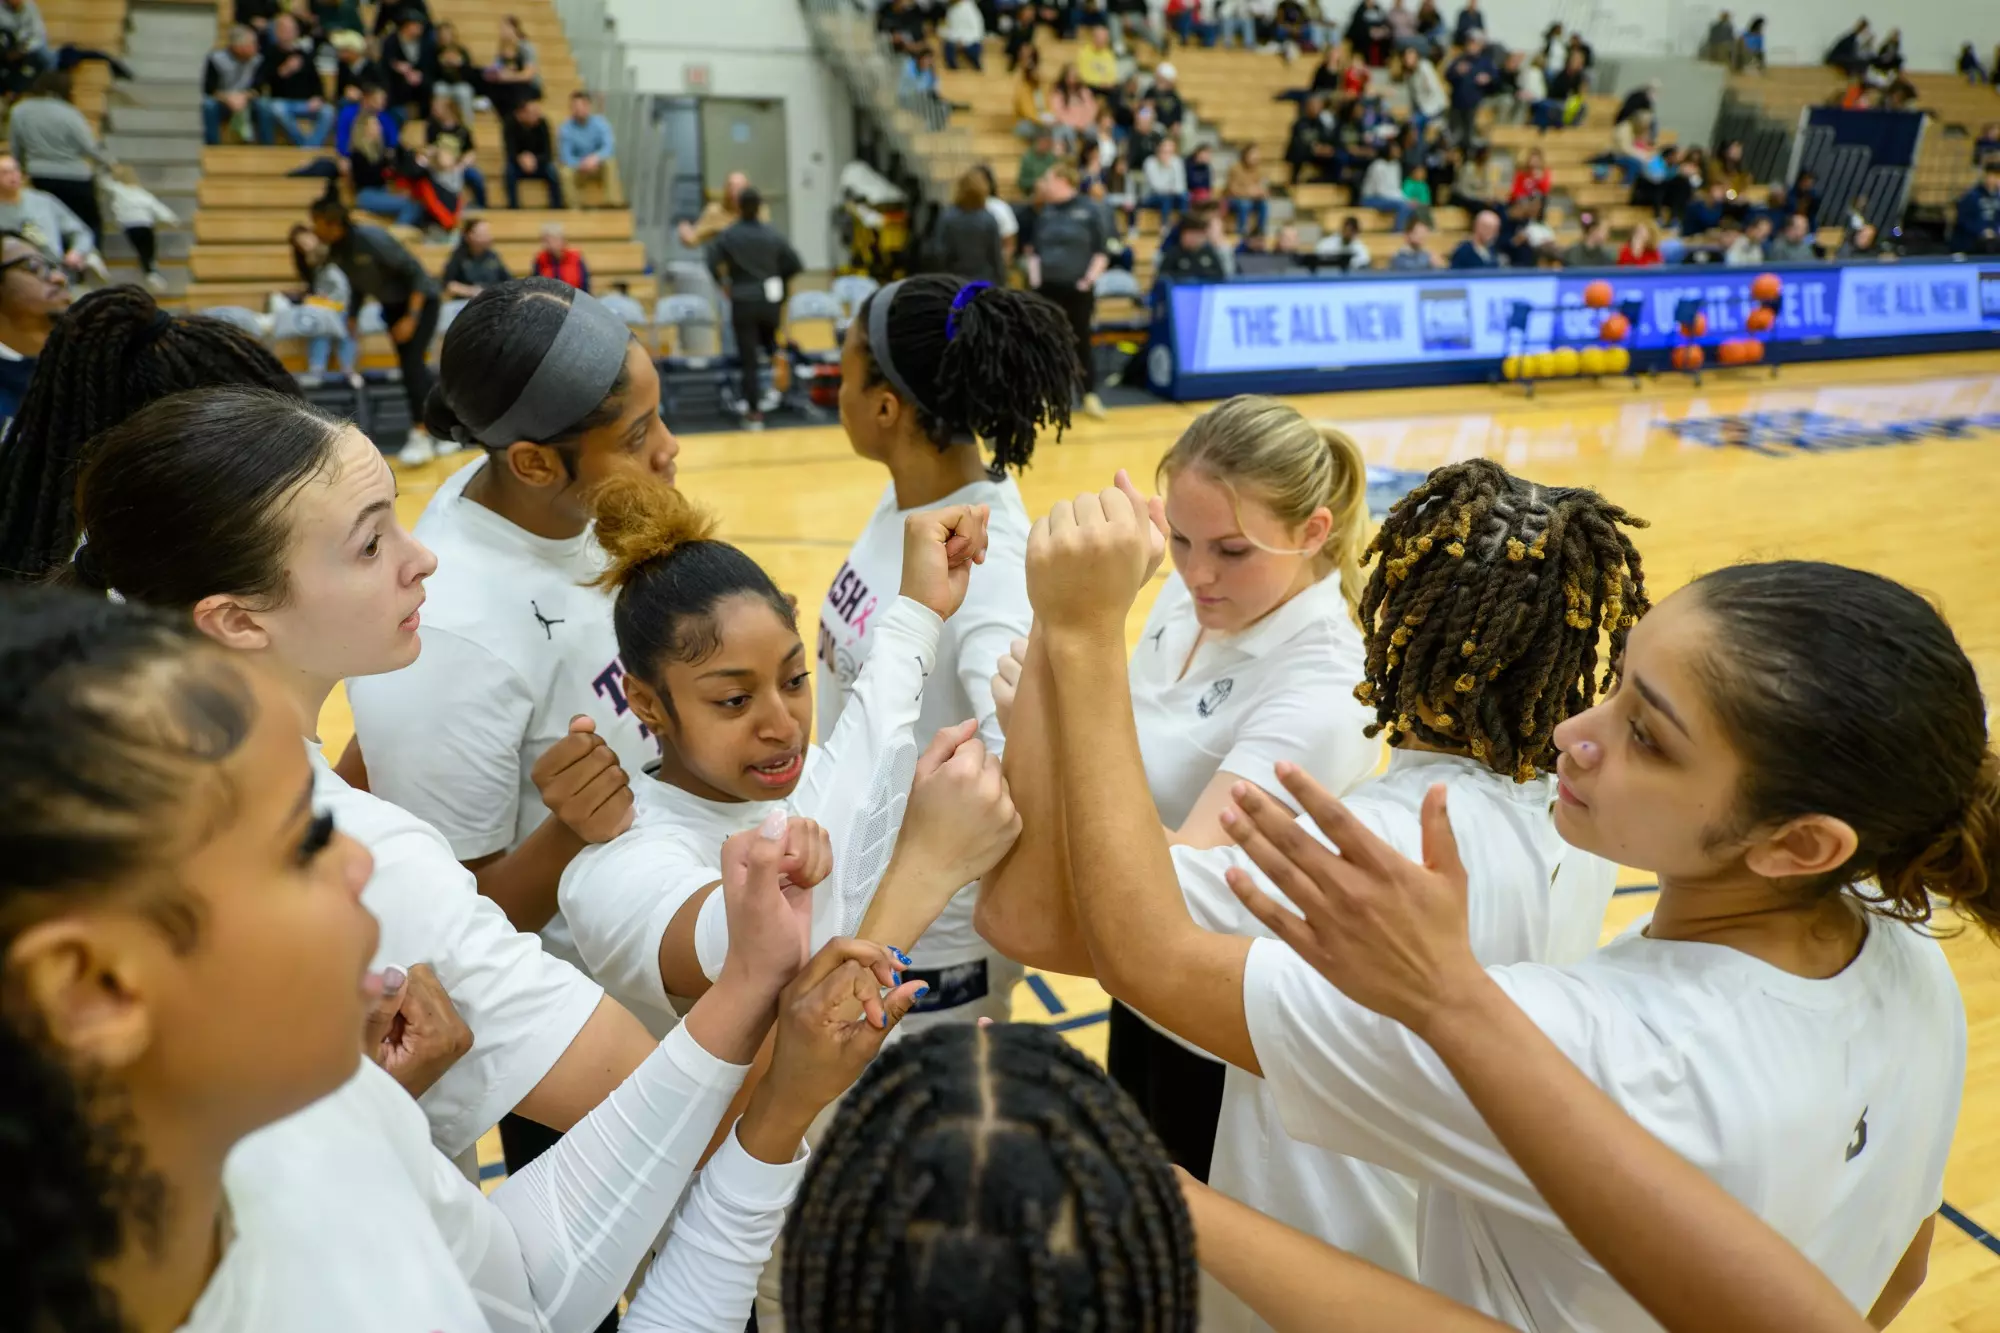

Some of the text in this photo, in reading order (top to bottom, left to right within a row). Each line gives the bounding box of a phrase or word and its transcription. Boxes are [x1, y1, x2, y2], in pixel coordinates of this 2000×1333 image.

[1226, 305, 1282, 348] THE
[1289, 303, 1339, 345] ALL
[1343, 301, 1404, 343] NEW
